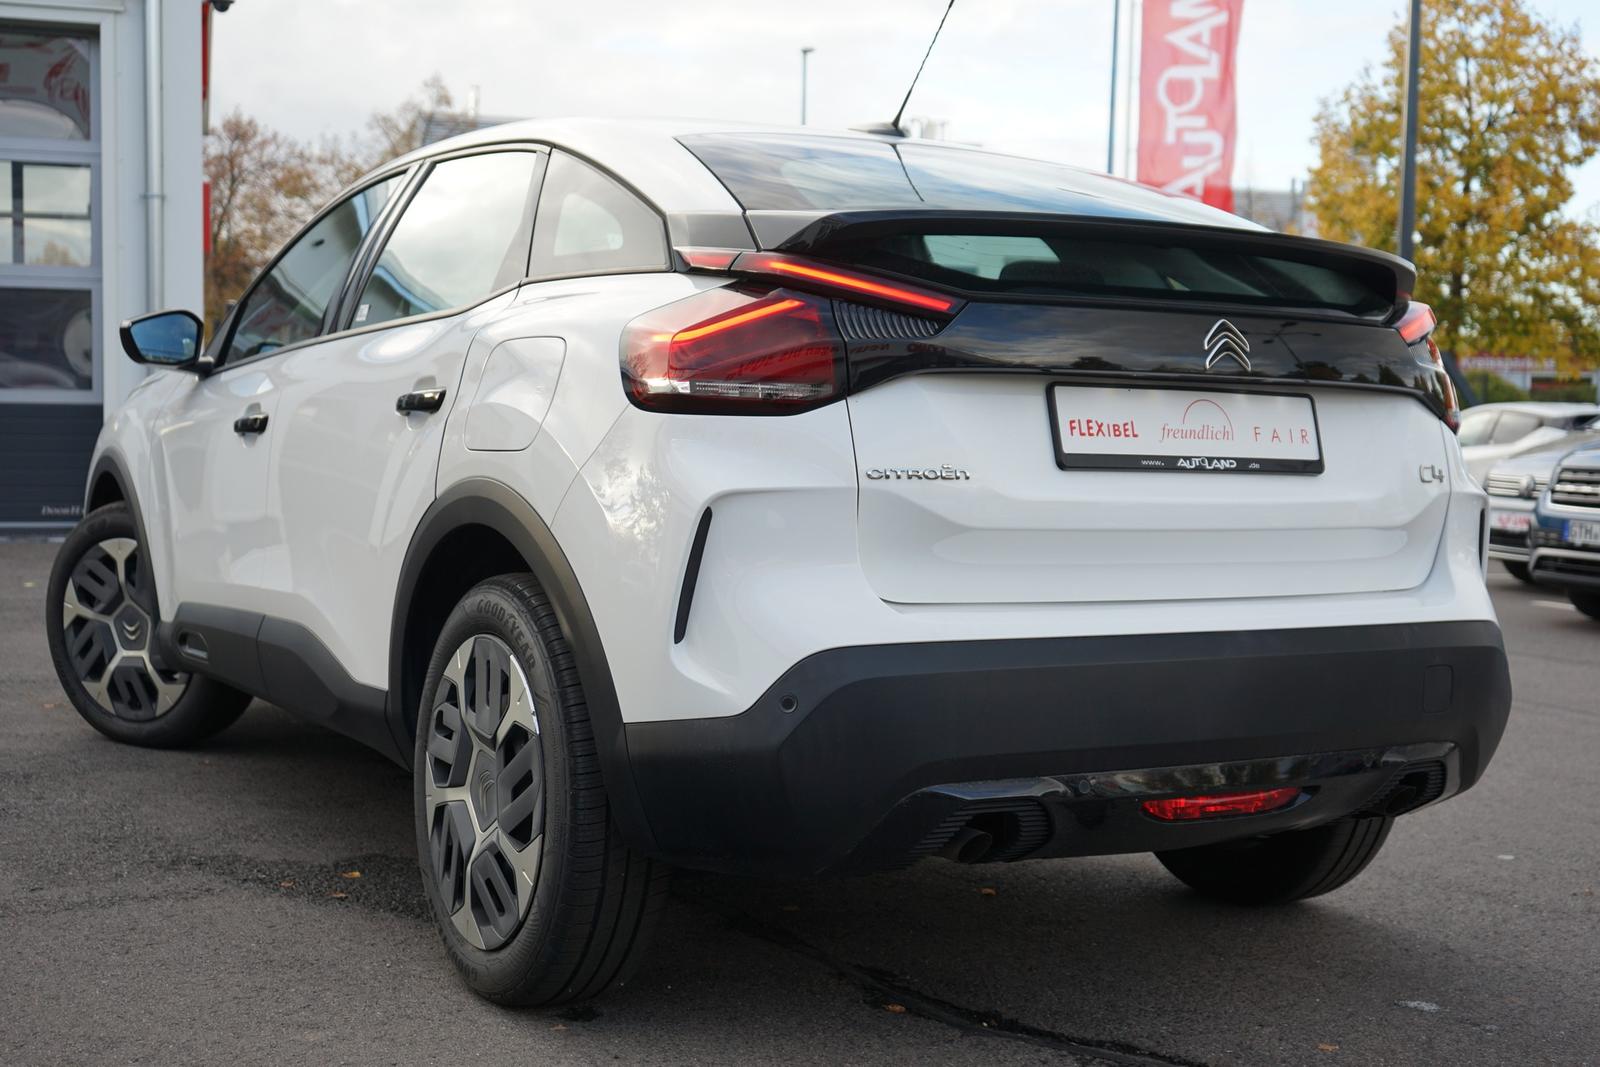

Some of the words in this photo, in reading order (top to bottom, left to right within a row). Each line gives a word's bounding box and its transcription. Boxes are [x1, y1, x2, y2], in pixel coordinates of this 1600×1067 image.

[1069, 419, 1139, 438] FLEXIBEL
[1159, 423, 1231, 443] freundlich
[1254, 426, 1309, 444] FAIR
[865, 464, 970, 480] CITROËN
[1177, 457, 1237, 470] AUTOLAND
[1419, 464, 1445, 483] C4
[477, 599, 537, 672] GOODYEAR
